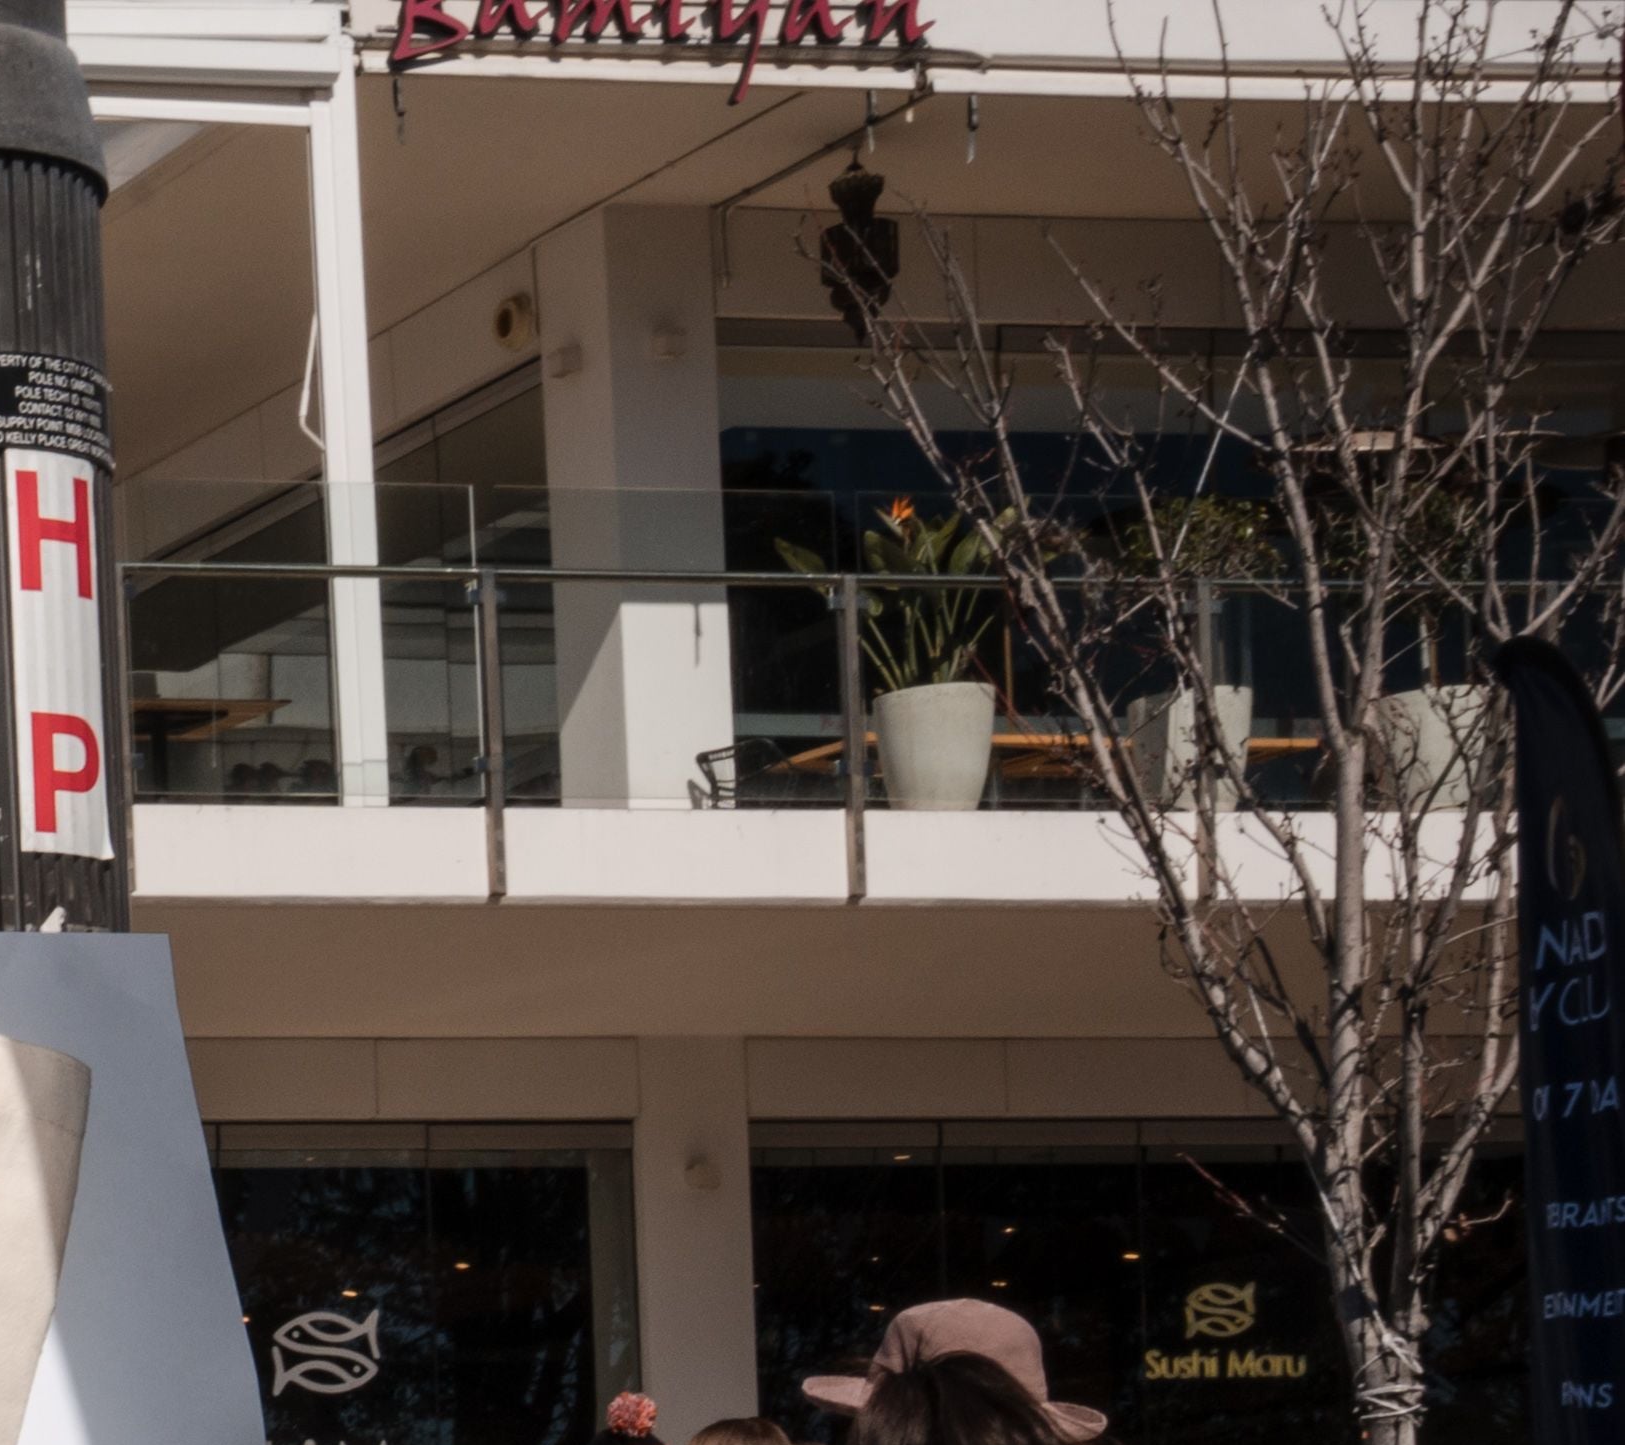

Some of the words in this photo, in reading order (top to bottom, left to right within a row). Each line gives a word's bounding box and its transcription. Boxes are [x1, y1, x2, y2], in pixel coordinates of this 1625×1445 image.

[28, 370, 54, 384] POLE
[14, 385, 42, 400] POLE
[5, 431, 38, 445] KELLY
[14, 469, 93, 601] H
[32, 710, 101, 834] P
[1144, 1348, 1220, 1380] Sushi
[1226, 1349, 1308, 1379] Maru
